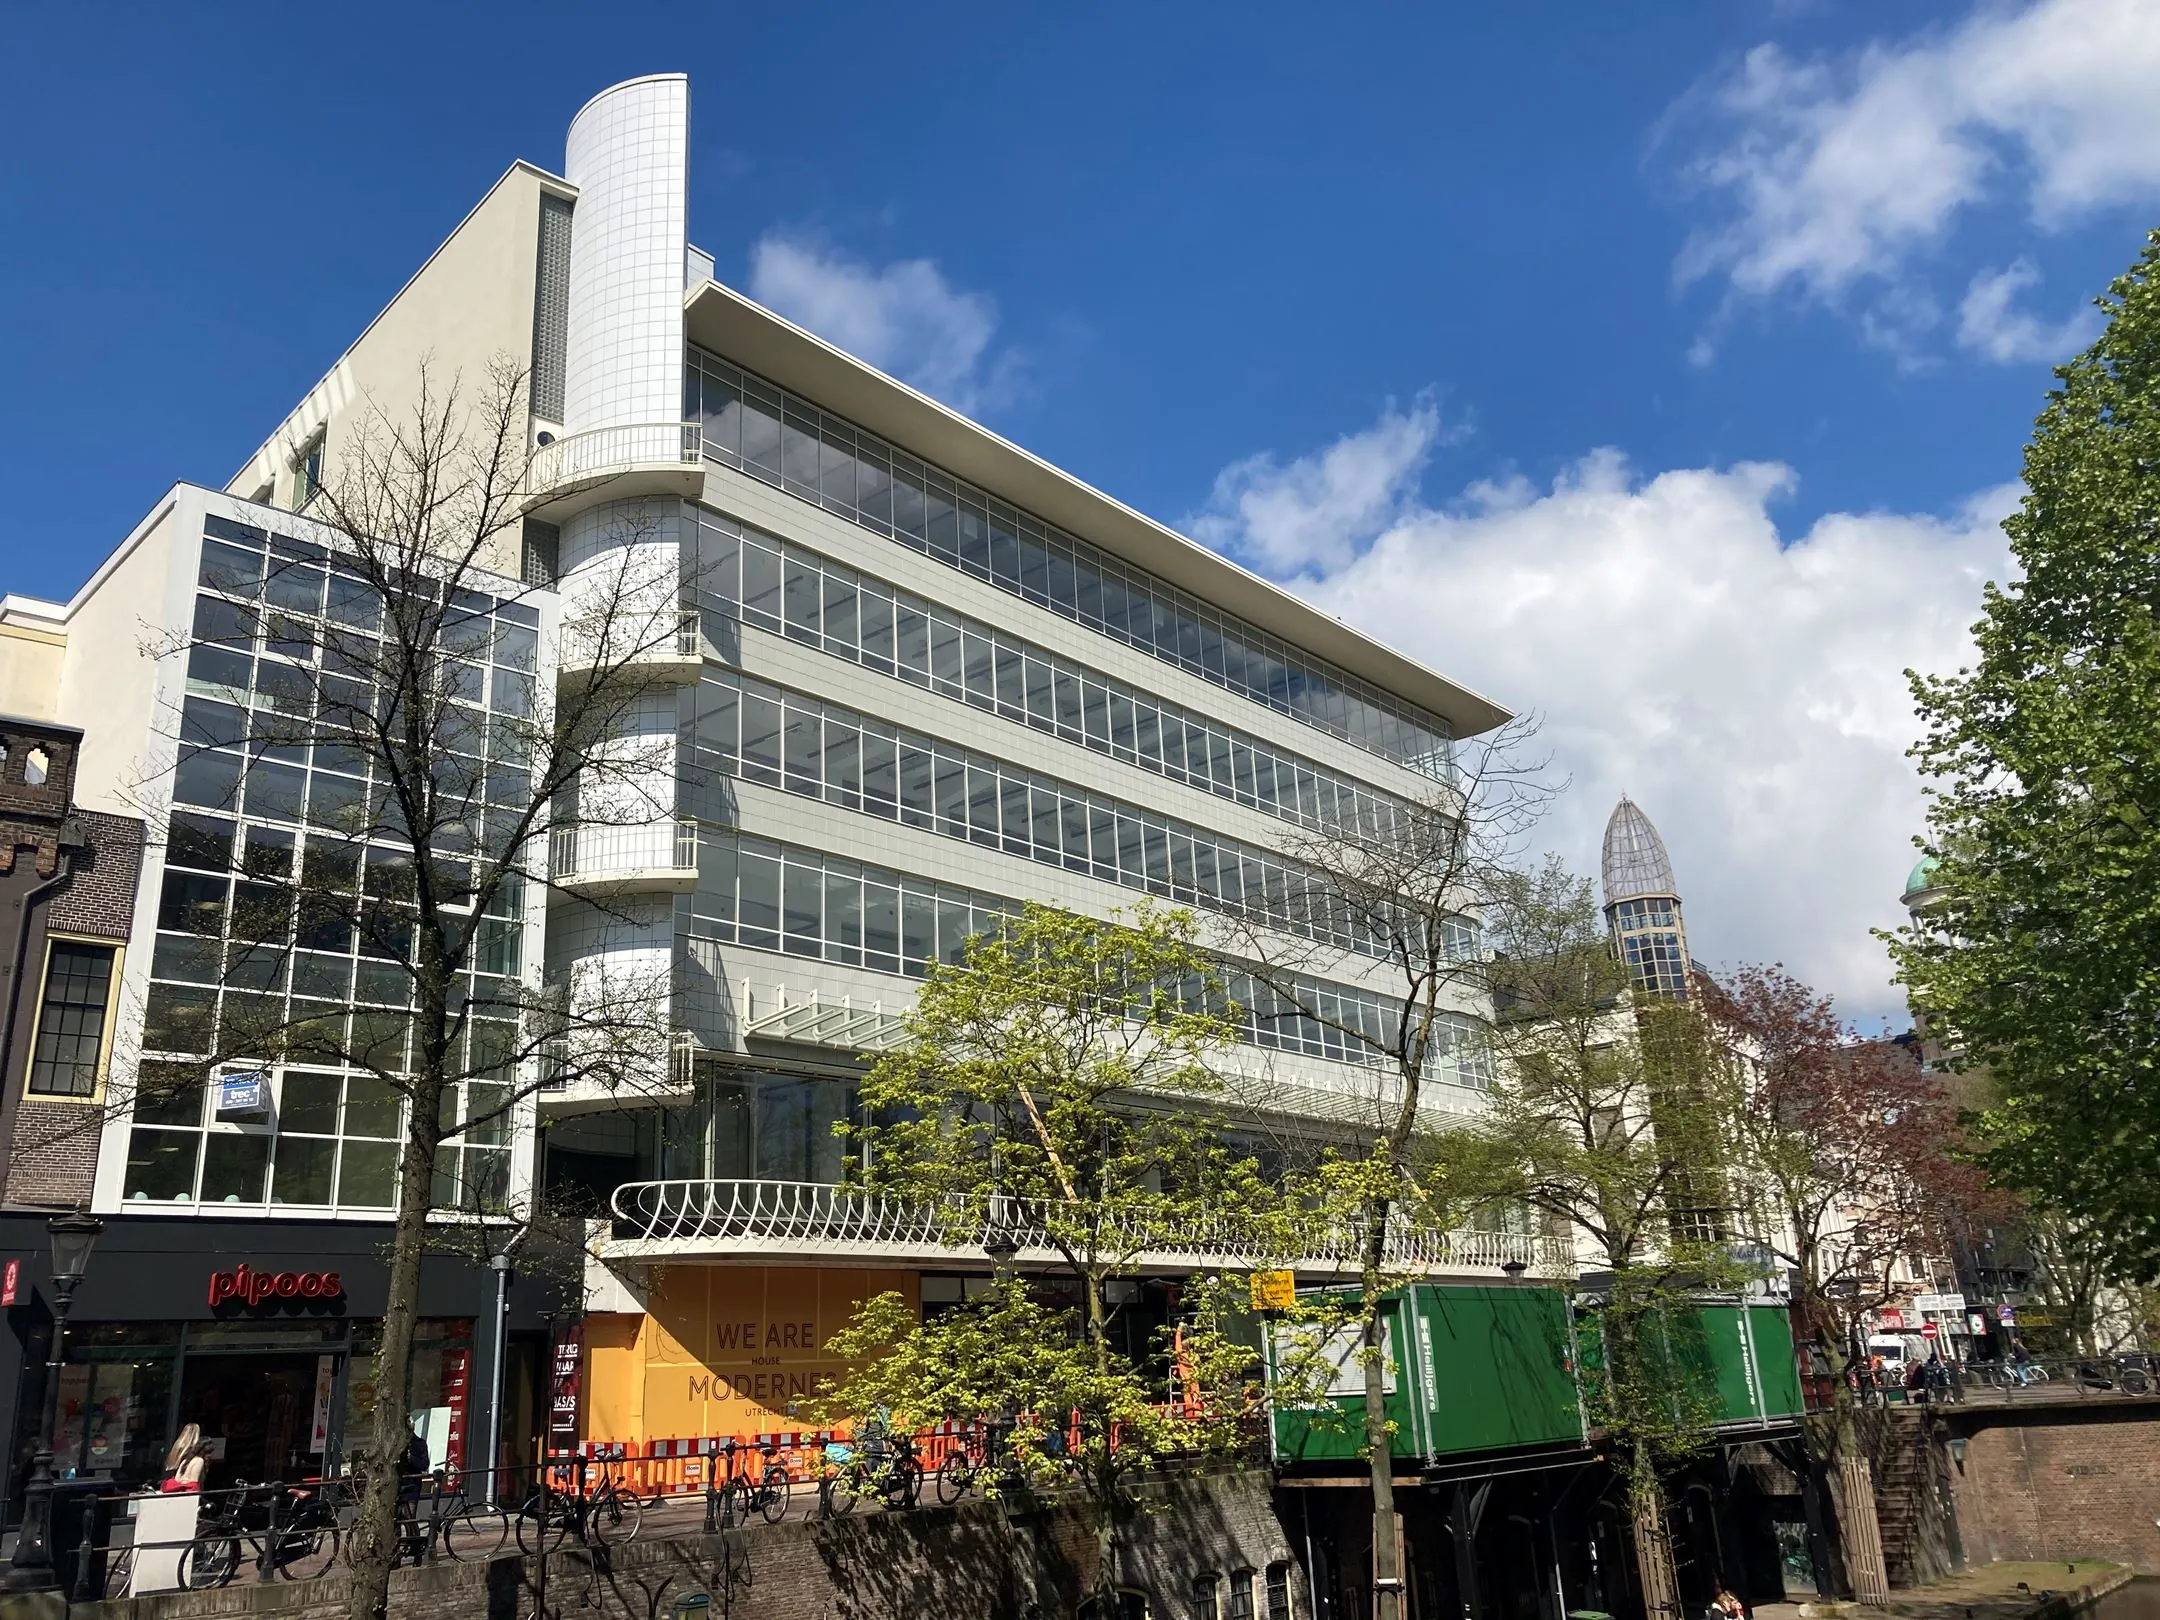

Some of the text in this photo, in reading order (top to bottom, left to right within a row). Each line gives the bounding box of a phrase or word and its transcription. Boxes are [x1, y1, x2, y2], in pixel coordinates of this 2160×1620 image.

[208, 1263, 341, 1306] pipoos
[716, 1323, 814, 1349] WE ARE
[751, 1356, 781, 1366] HOUSE
[688, 1371, 837, 1401] MODERNES
[745, 1407, 786, 1417] UTRECHT
